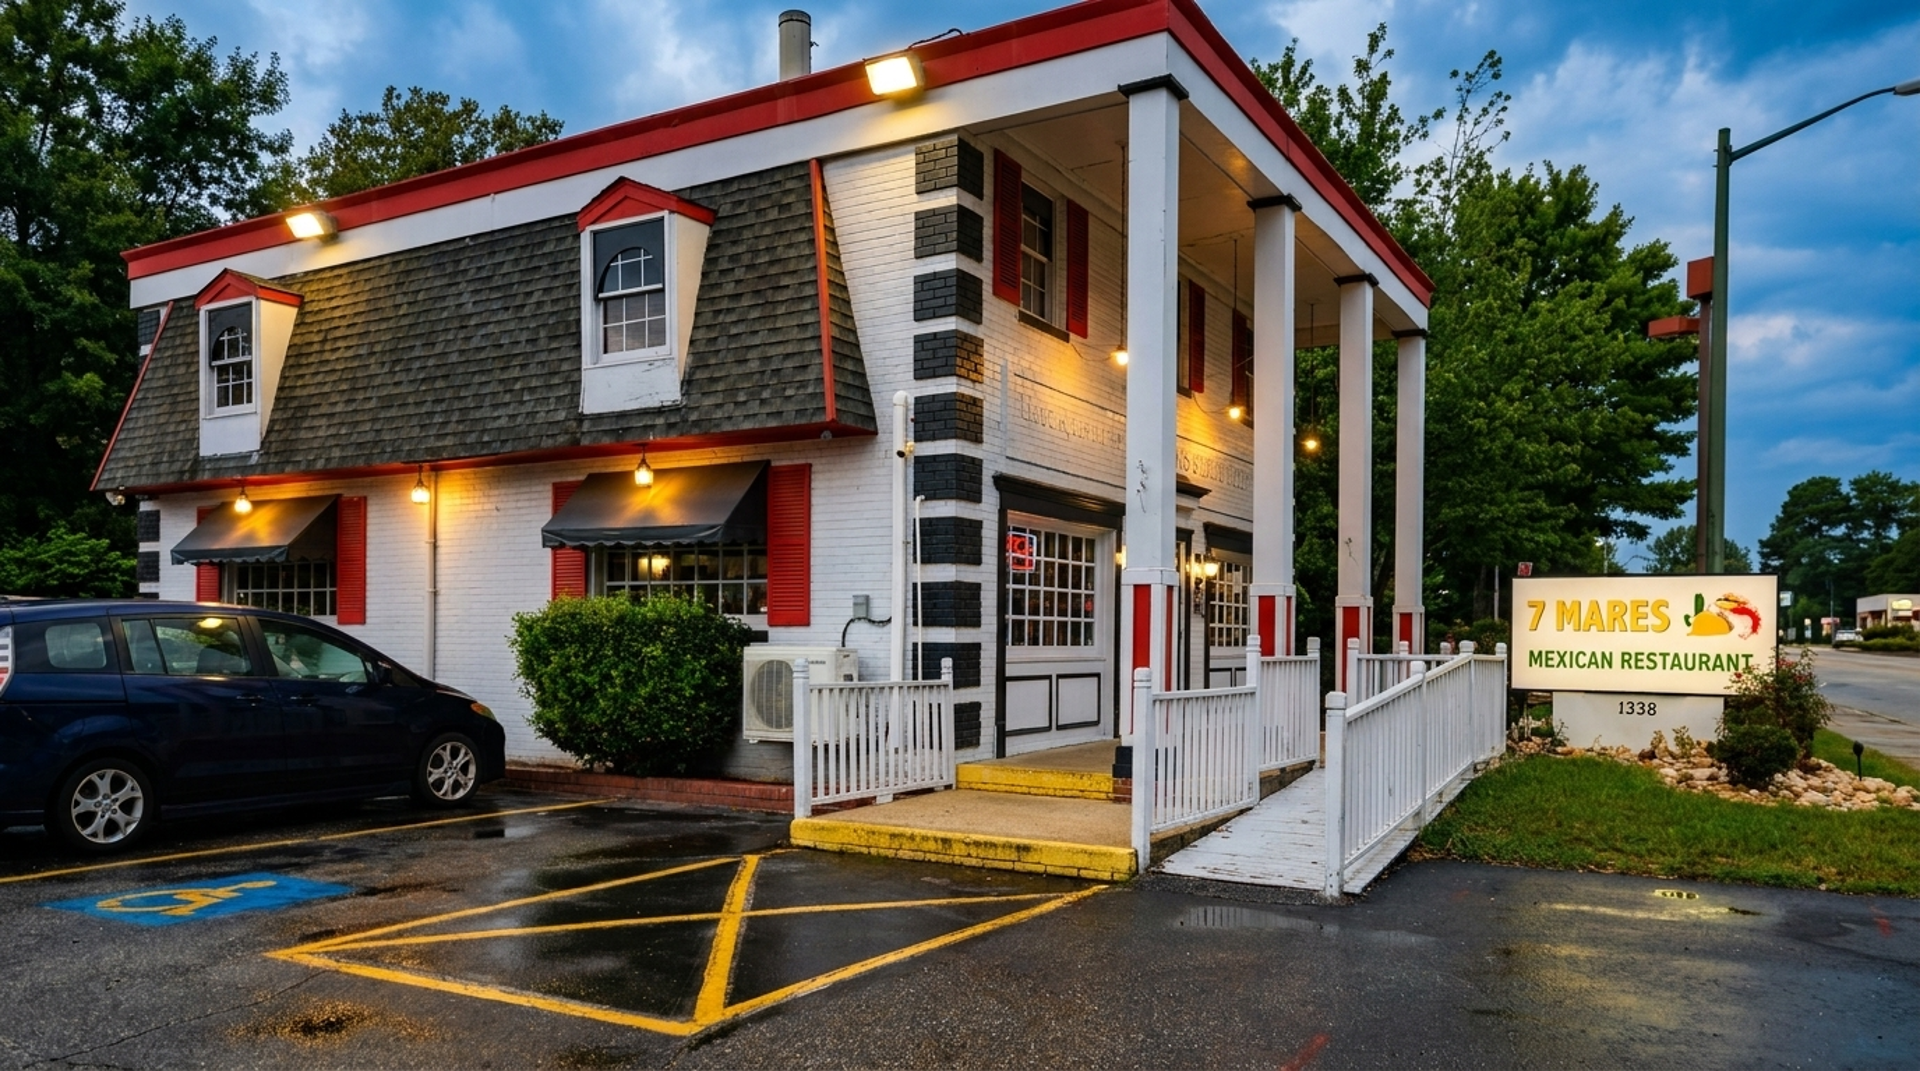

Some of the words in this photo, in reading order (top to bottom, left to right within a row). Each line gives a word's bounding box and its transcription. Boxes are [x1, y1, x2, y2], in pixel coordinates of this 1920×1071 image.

[1527, 600, 1546, 631] 7
[1556, 599, 1671, 633] MARES
[1528, 650, 1613, 669] MEXICAN
[1621, 651, 1754, 672] RESTAURANT
[1618, 701, 1657, 716] 1338
